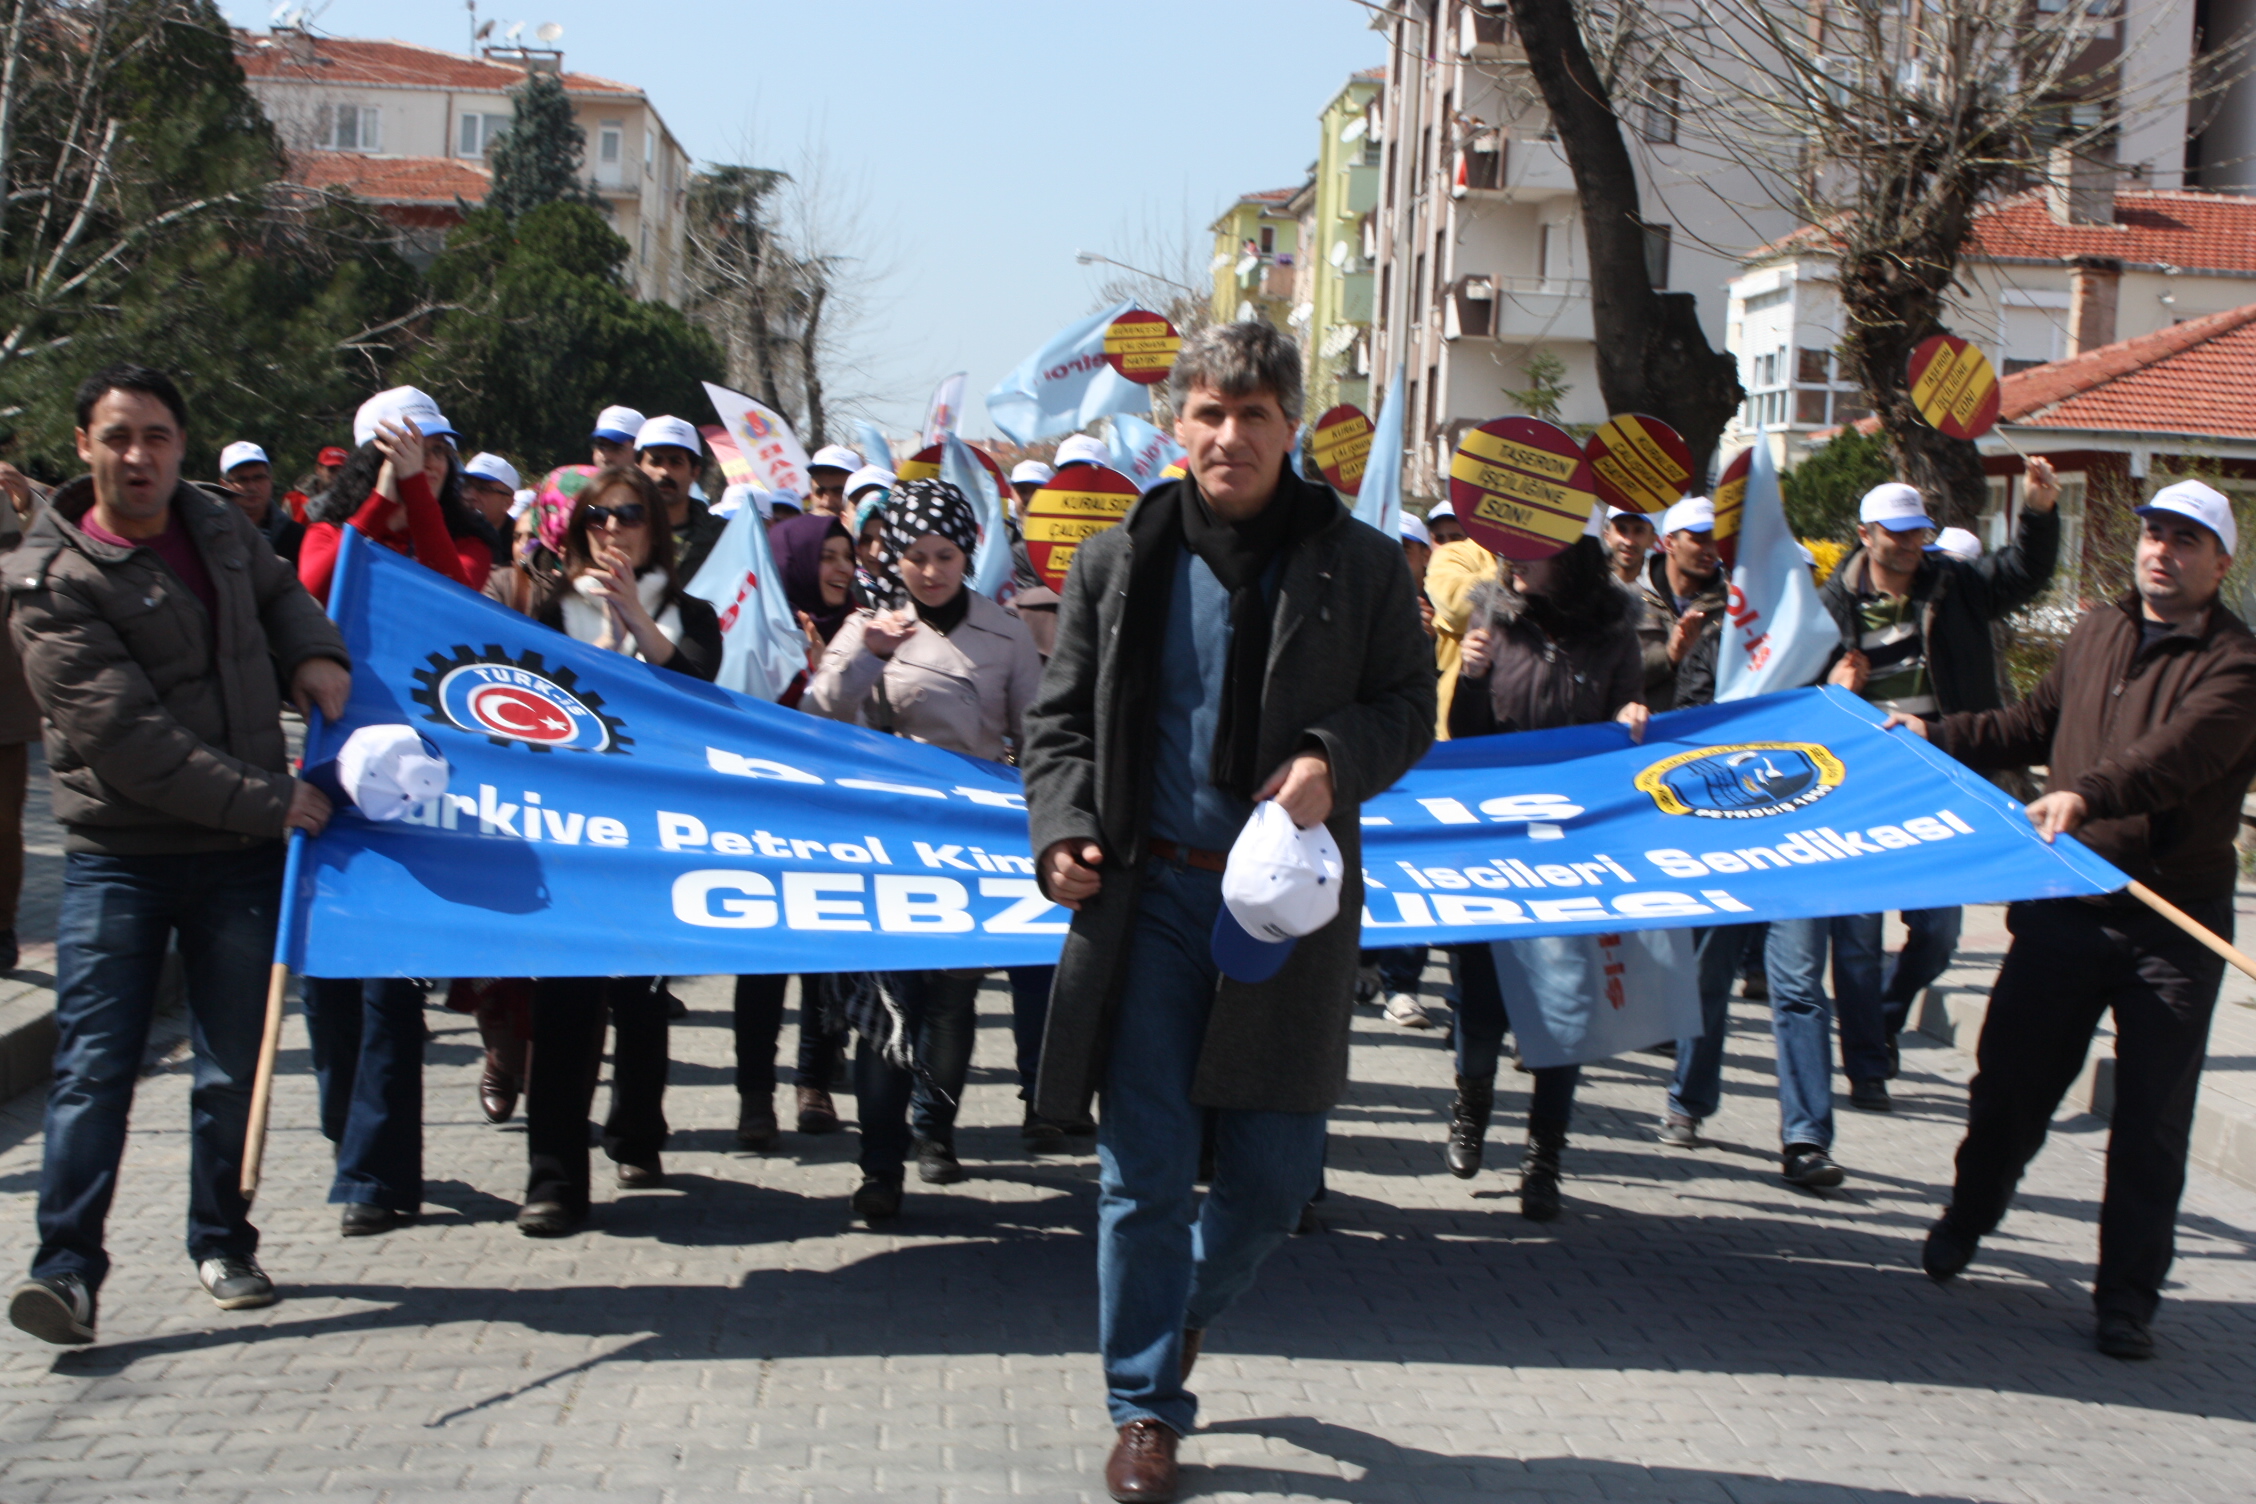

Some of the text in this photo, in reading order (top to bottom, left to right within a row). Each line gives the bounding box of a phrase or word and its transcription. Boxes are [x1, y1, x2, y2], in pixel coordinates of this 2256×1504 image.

[1500, 443, 1571, 475] TAŞERON
[1477, 465, 1567, 504] İŞÇİLİĞİNE
[1483, 499, 1534, 525] SON!
[657, 810, 892, 865] Petrol
[671, 869, 1070, 934] GEBZ
